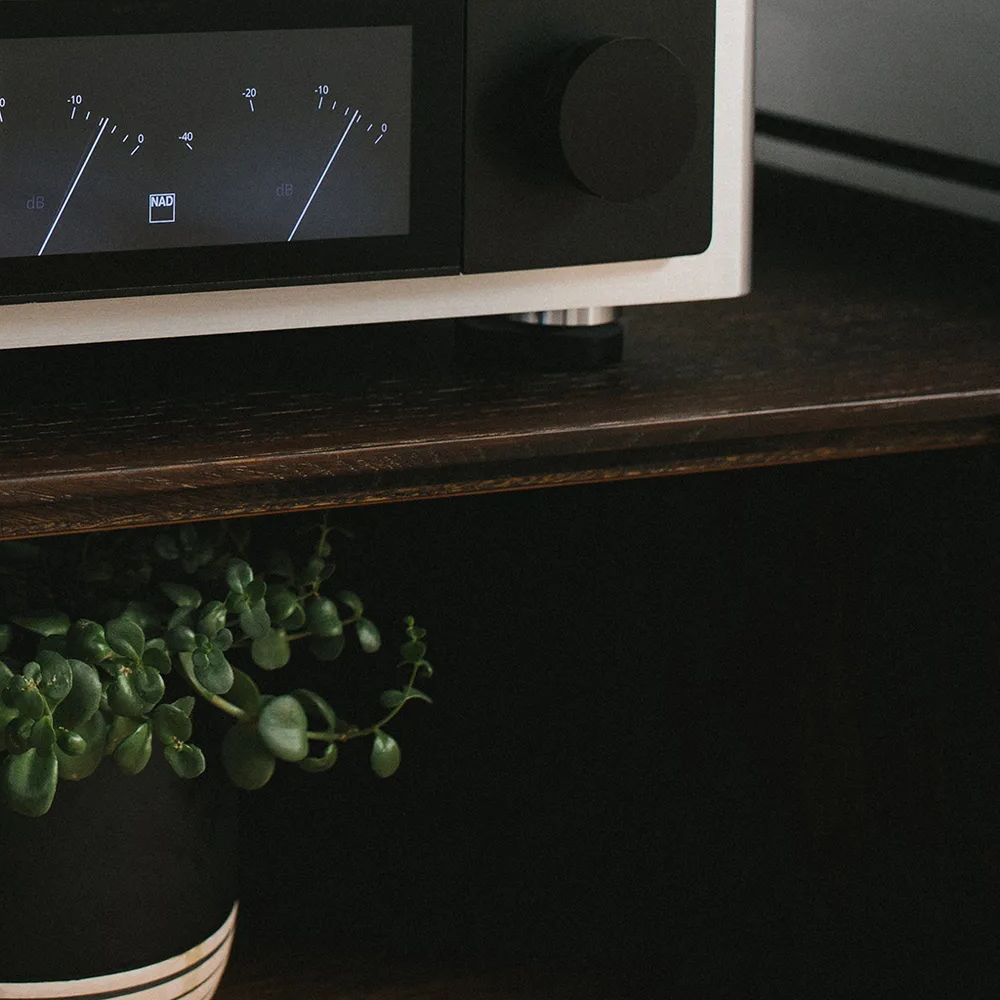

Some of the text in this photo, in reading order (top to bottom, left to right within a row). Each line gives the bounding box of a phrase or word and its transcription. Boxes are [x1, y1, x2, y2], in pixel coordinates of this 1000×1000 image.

[241, 88, 257, 98] -20
[314, 85, 329, 95] -10
[66, 95, 82, 104] -10
[381, 123, 388, 133] 0
[137, 134, 145, 143] 0
[178, 132, 194, 141] -40
[276, 183, 294, 197] dB
[26, 195, 45, 210] dB
[150, 196, 174, 208] NAD
